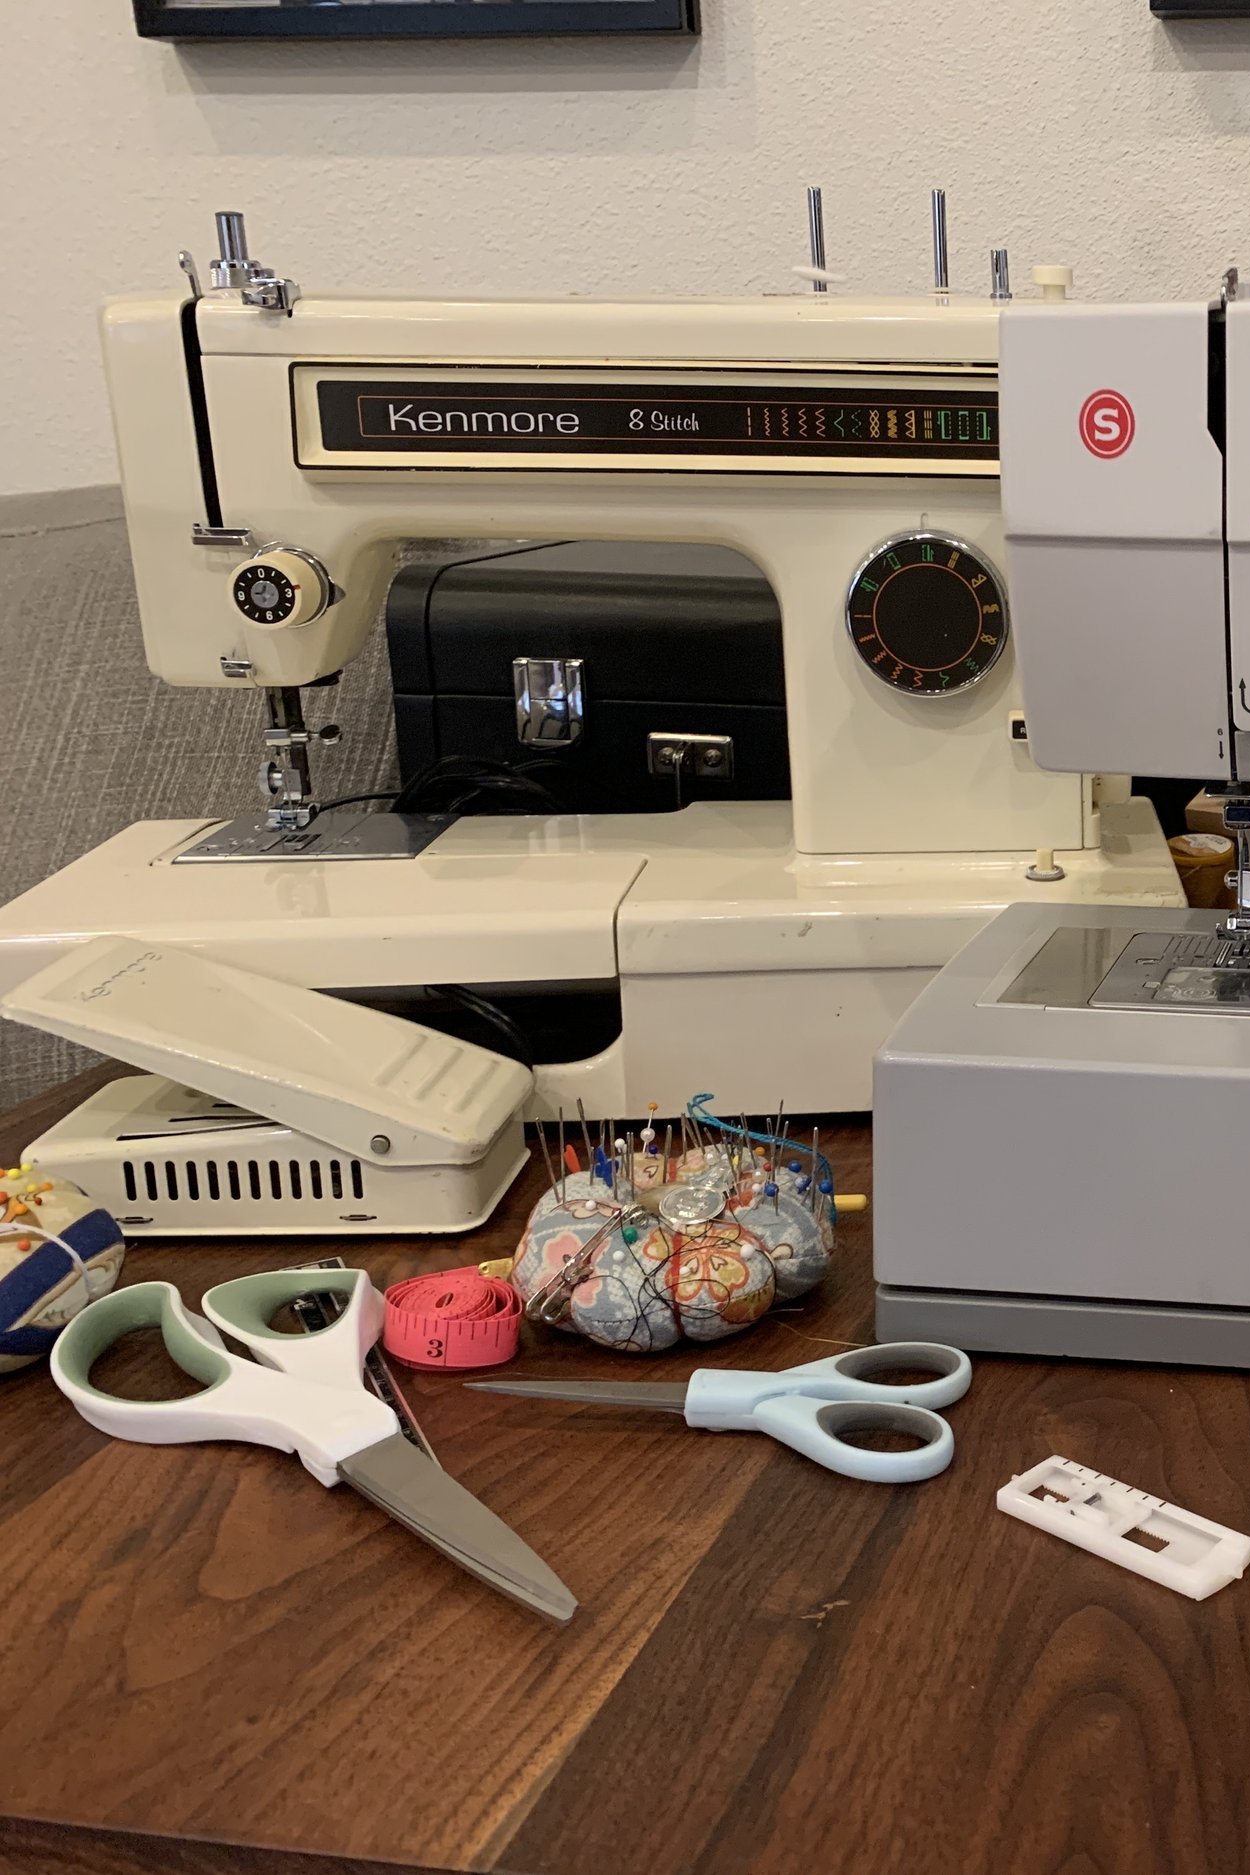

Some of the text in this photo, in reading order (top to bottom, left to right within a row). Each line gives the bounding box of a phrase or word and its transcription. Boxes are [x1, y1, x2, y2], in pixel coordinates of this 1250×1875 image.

[388, 403, 580, 434] Kenmore
[628, 410, 700, 433] 8 Stitch
[1093, 407, 1121, 442] S
[257, 568, 265, 578] 0
[237, 591, 246, 601] 9
[285, 588, 293, 598] 3
[266, 611, 274, 621] 6
[1217, 728, 1224, 736] 6
[426, 1338, 444, 1359] 3
